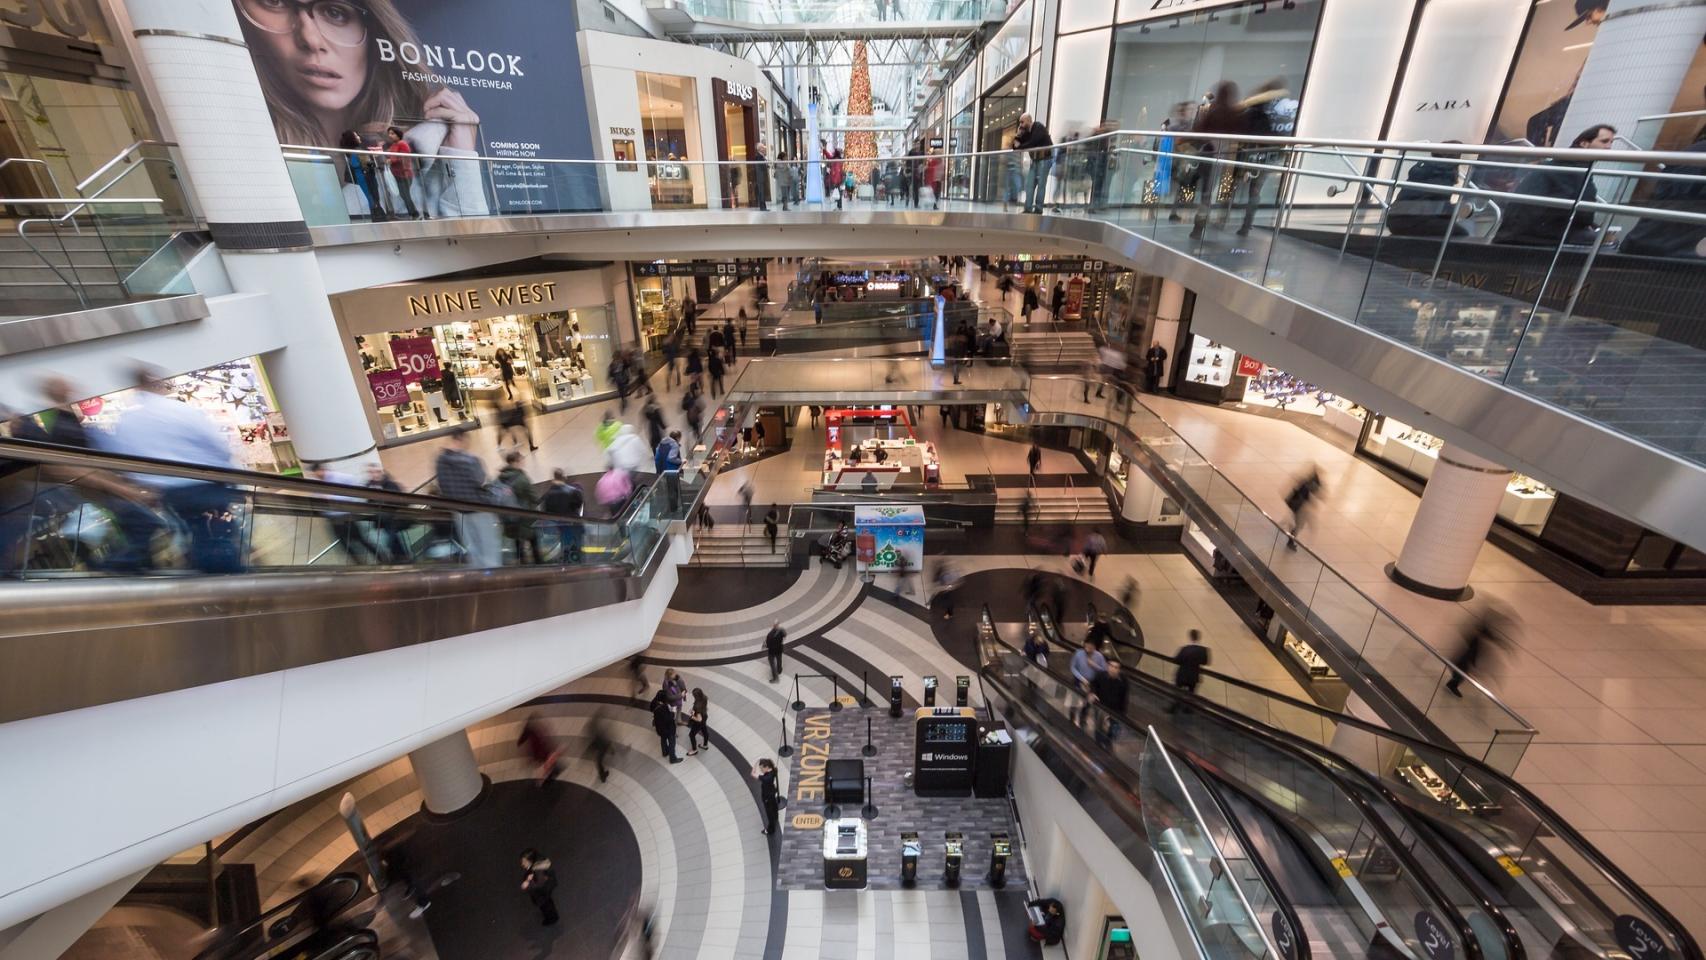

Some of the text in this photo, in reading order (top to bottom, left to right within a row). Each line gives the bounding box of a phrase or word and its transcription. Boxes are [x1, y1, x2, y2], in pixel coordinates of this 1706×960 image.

[376, 38, 524, 76] BONLOOK
[402, 71, 513, 90] FASHIONABLE EYEWEAR
[726, 80, 753, 100] BIRKS
[1416, 99, 1471, 112] ZARA
[609, 126, 636, 136] BIRKS
[490, 141, 541, 150] COMING SOON
[409, 281, 557, 317] NINE WEST
[397, 353, 436, 376] 50%
[375, 382, 404, 399] 30%
[796, 714, 832, 801] VR ZONE
[934, 753, 968, 761] Windows
[1279, 932, 1291, 955] 2
[1425, 916, 1450, 949] Level
[1629, 920, 1664, 953] Level
[1424, 934, 1440, 956] 2
[1628, 937, 1648, 959] 2
